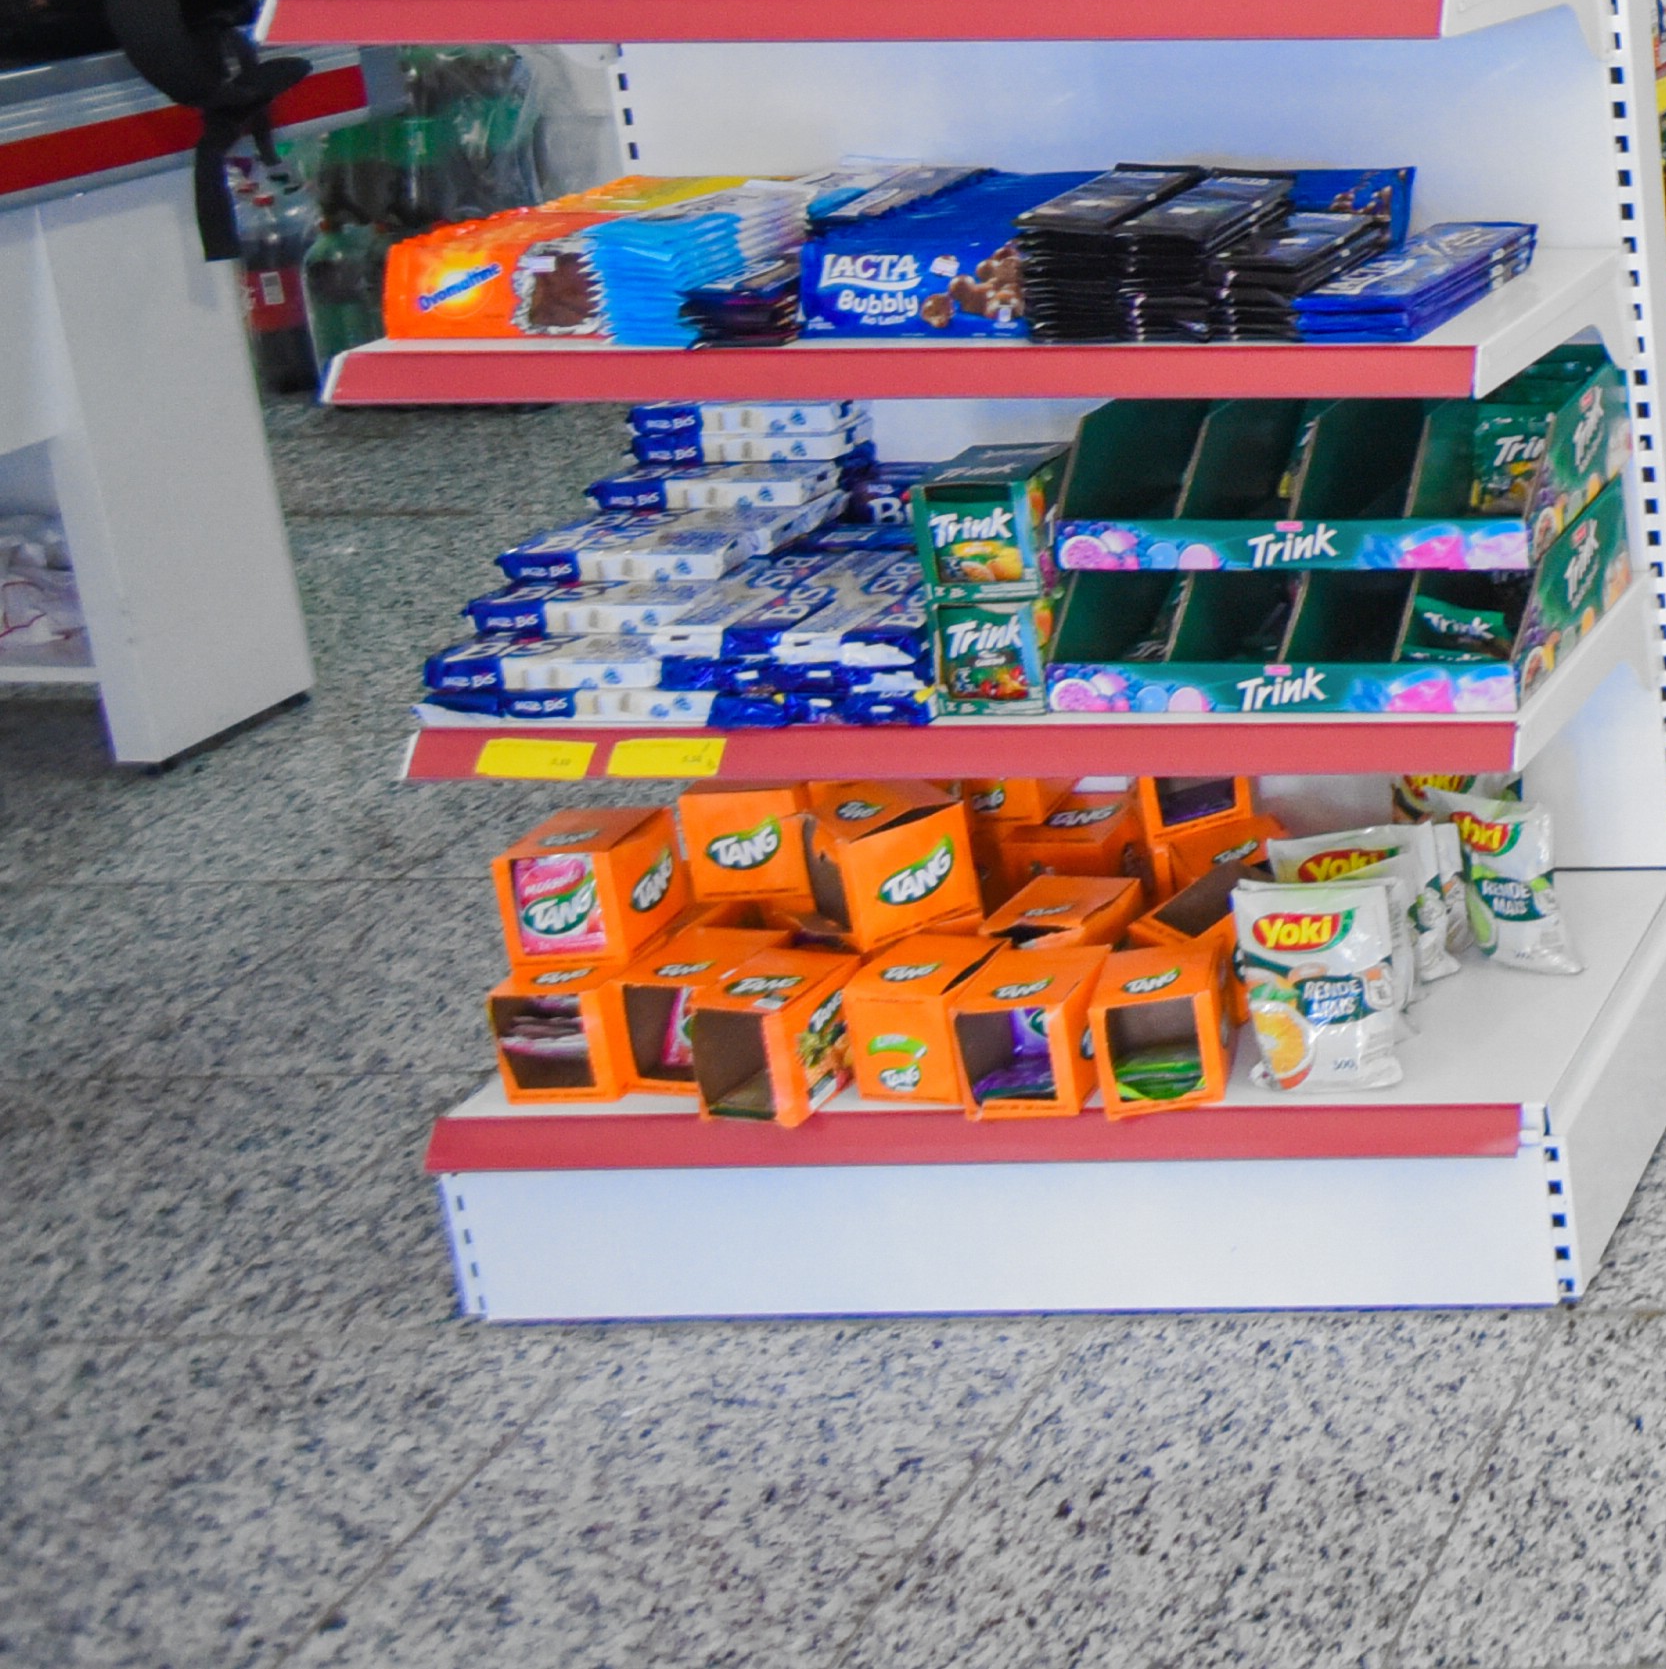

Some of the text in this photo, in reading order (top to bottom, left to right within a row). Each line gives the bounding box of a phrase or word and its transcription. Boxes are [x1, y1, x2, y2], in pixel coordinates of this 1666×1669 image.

[418, 261, 501, 312] Ovomaltine
[821, 253, 922, 282] LACTA
[837, 289, 918, 318] Bubbly
[929, 508, 1013, 543] Trink
[1248, 524, 1337, 567] Trink
[947, 616, 1022, 654] Trink
[1236, 669, 1325, 712] Trink
[712, 826, 780, 867] TANG
[882, 852, 953, 902] TANG
[529, 881, 595, 931] TANG
[1254, 913, 1333, 949] Yoki
[1303, 980, 1361, 1001] RENDE
